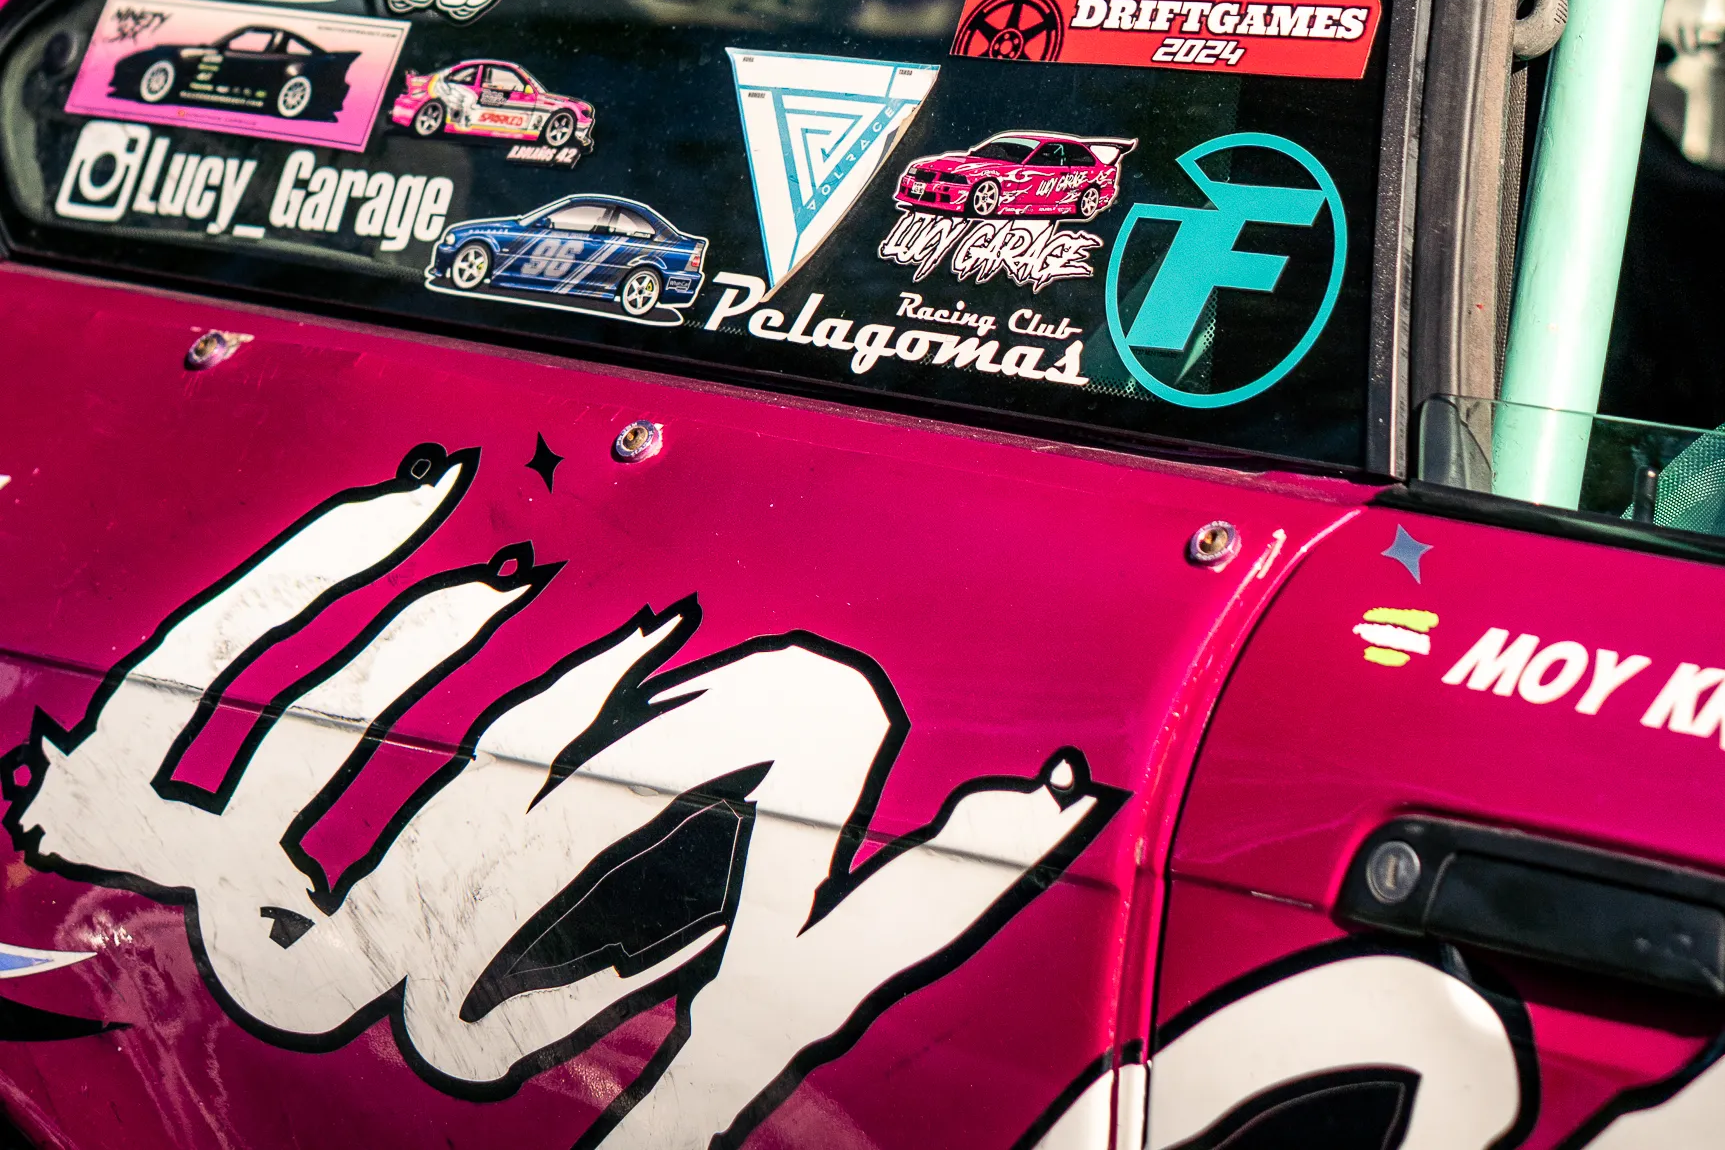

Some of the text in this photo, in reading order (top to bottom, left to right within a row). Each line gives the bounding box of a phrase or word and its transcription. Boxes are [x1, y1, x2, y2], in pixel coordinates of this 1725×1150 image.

[1151, 36, 1245, 66] 2024
[521, 238, 585, 278] 96
[881, 210, 1103, 290] LUCY GARAGE
[703, 271, 1090, 386] Pelagomas
[896, 291, 1083, 339] Racing Club
[1441, 626, 1725, 756] MOY K
